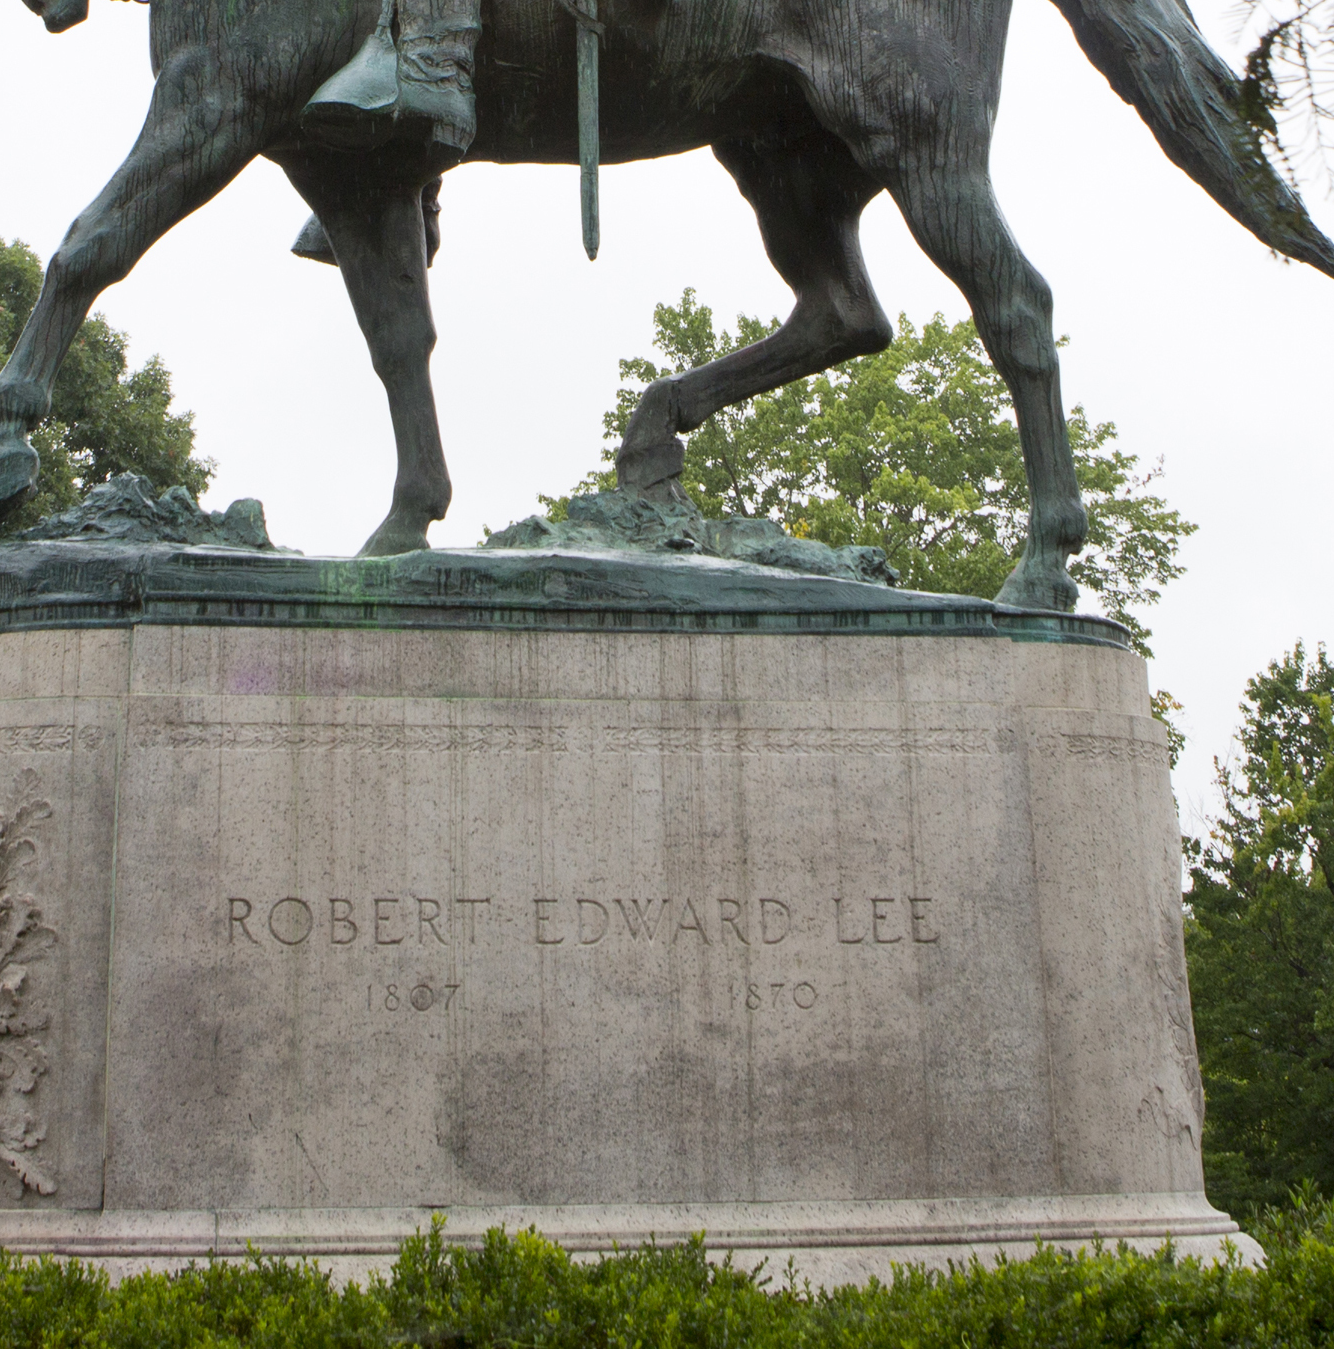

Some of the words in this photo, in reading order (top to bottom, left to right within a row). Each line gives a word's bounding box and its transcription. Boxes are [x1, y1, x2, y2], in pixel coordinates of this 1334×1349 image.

[226, 896, 491, 947] ROBERT
[533, 897, 792, 947] EDWARD
[831, 896, 941, 946] LEE
[366, 982, 461, 1012] 1807
[728, 980, 819, 1010] 1870
